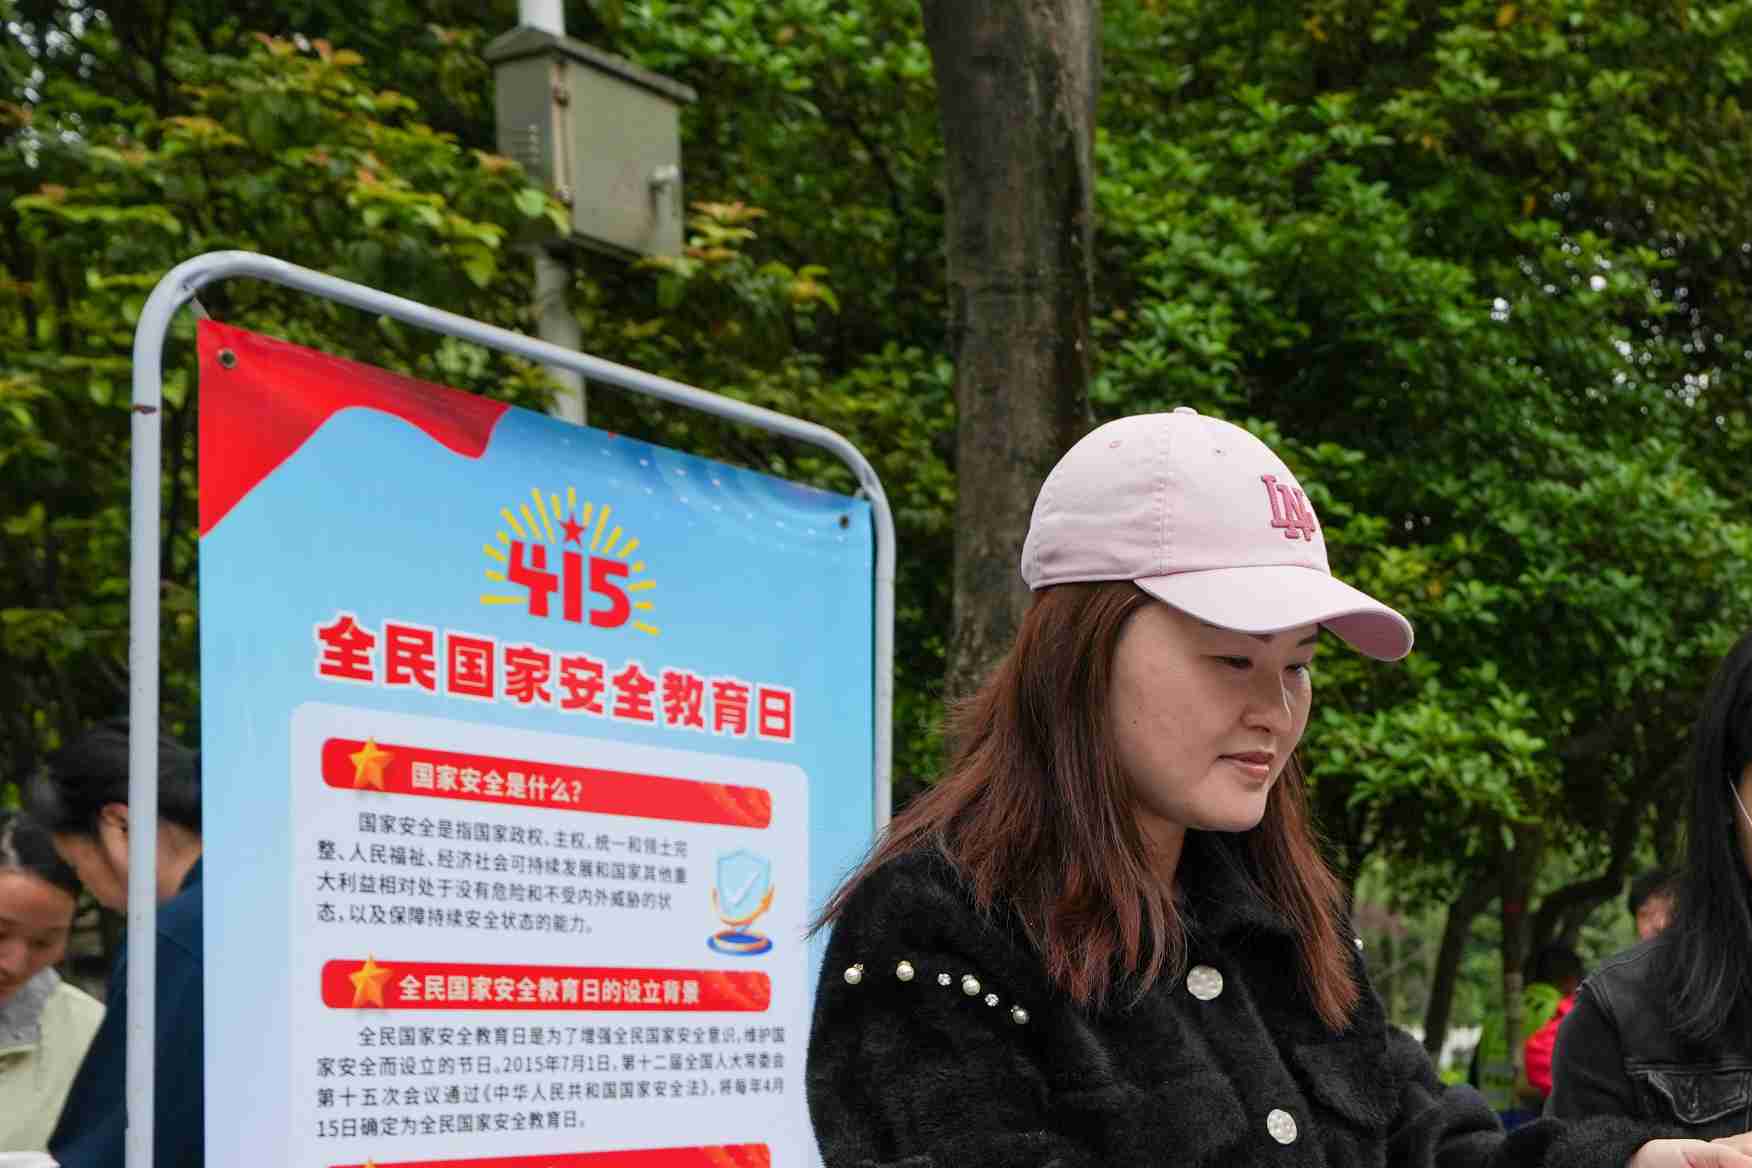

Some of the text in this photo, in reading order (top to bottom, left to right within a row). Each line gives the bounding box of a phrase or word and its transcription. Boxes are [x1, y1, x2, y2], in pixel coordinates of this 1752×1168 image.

[507, 540, 632, 629] 415
[317, 615, 793, 740] 全民国家安全教育日
[411, 762, 583, 803] 国家安全是什么？
[399, 976, 700, 1005] 全民国家安全教育日的设立背景
